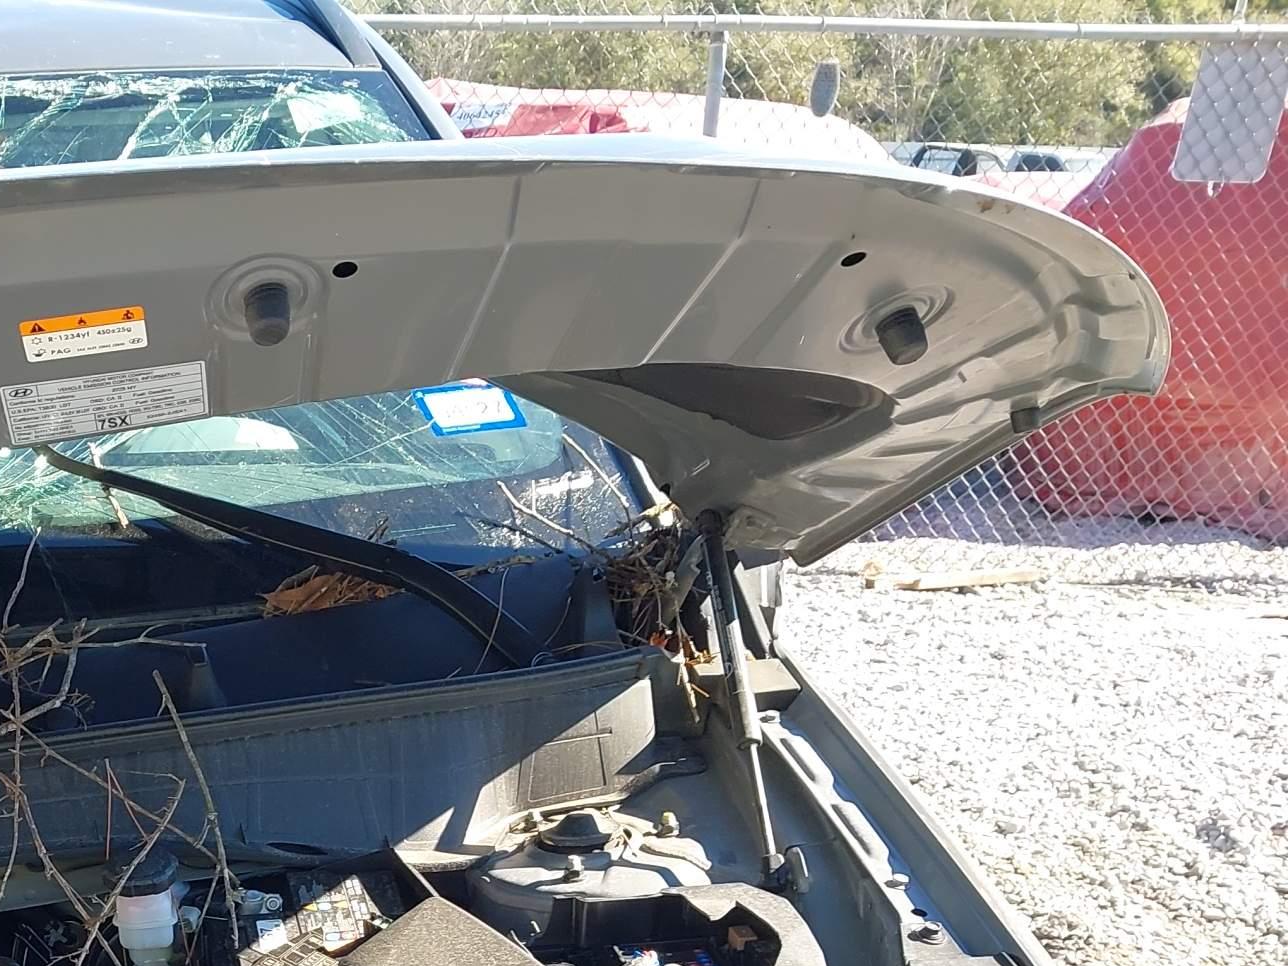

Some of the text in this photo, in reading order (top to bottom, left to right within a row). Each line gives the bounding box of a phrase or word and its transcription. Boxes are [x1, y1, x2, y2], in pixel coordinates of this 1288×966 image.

[48, 332, 90, 343] R-1234yf
[51, 347, 71, 356] PAG
[98, 416, 130, 430] 7SX
